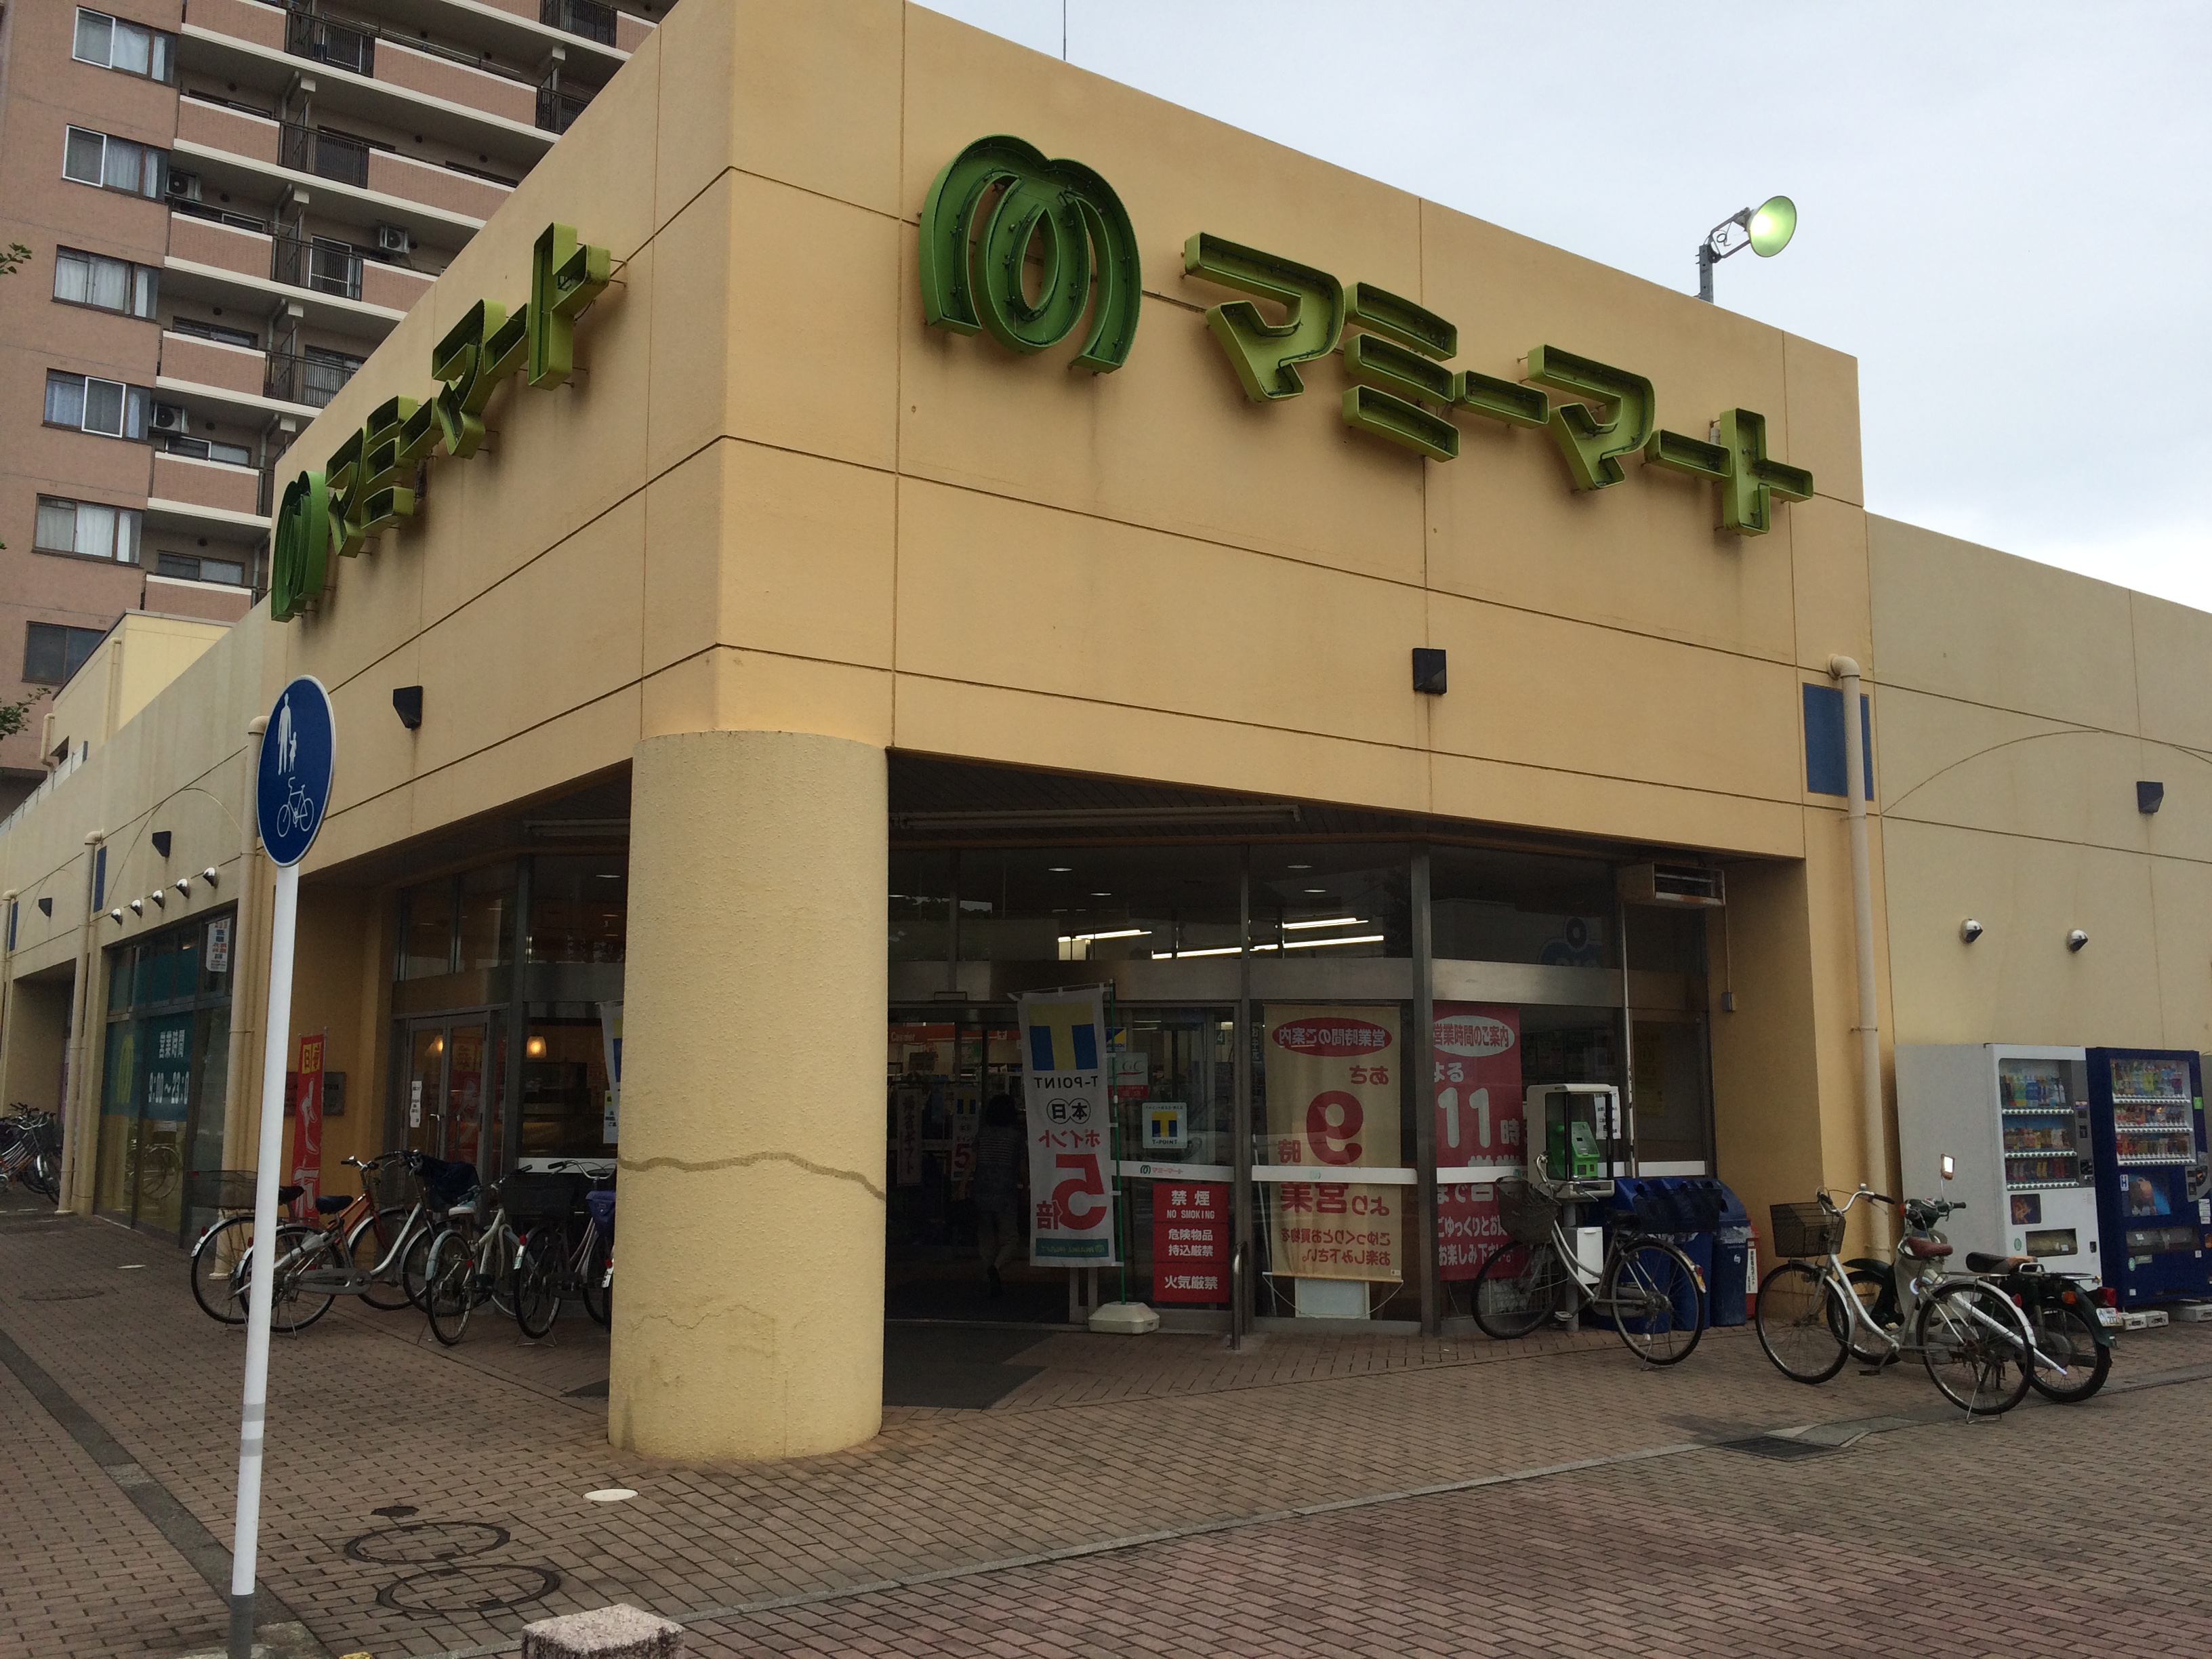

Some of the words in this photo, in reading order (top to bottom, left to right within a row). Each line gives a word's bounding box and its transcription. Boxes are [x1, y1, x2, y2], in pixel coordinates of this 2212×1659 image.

[325, 222, 611, 557] マミーマート
[1184, 230, 1814, 537] マミーマート
[1433, 1023, 1509, 1048] 営業時間のご案内
[159, 1029, 185, 1059] 営業時間
[1434, 1061, 1464, 1083] よる
[1151, 1166, 1184, 1174] マミーマート
[1171, 1190, 1210, 1206] 禁煙
[1166, 1209, 1176, 1218] NO
[1181, 1210, 1215, 1219] SMOKING
[1168, 1228, 1213, 1241] 危険物品
[1168, 1244, 1213, 1257] 持込厳禁
[1164, 1275, 1218, 1290] 火気厳禁
